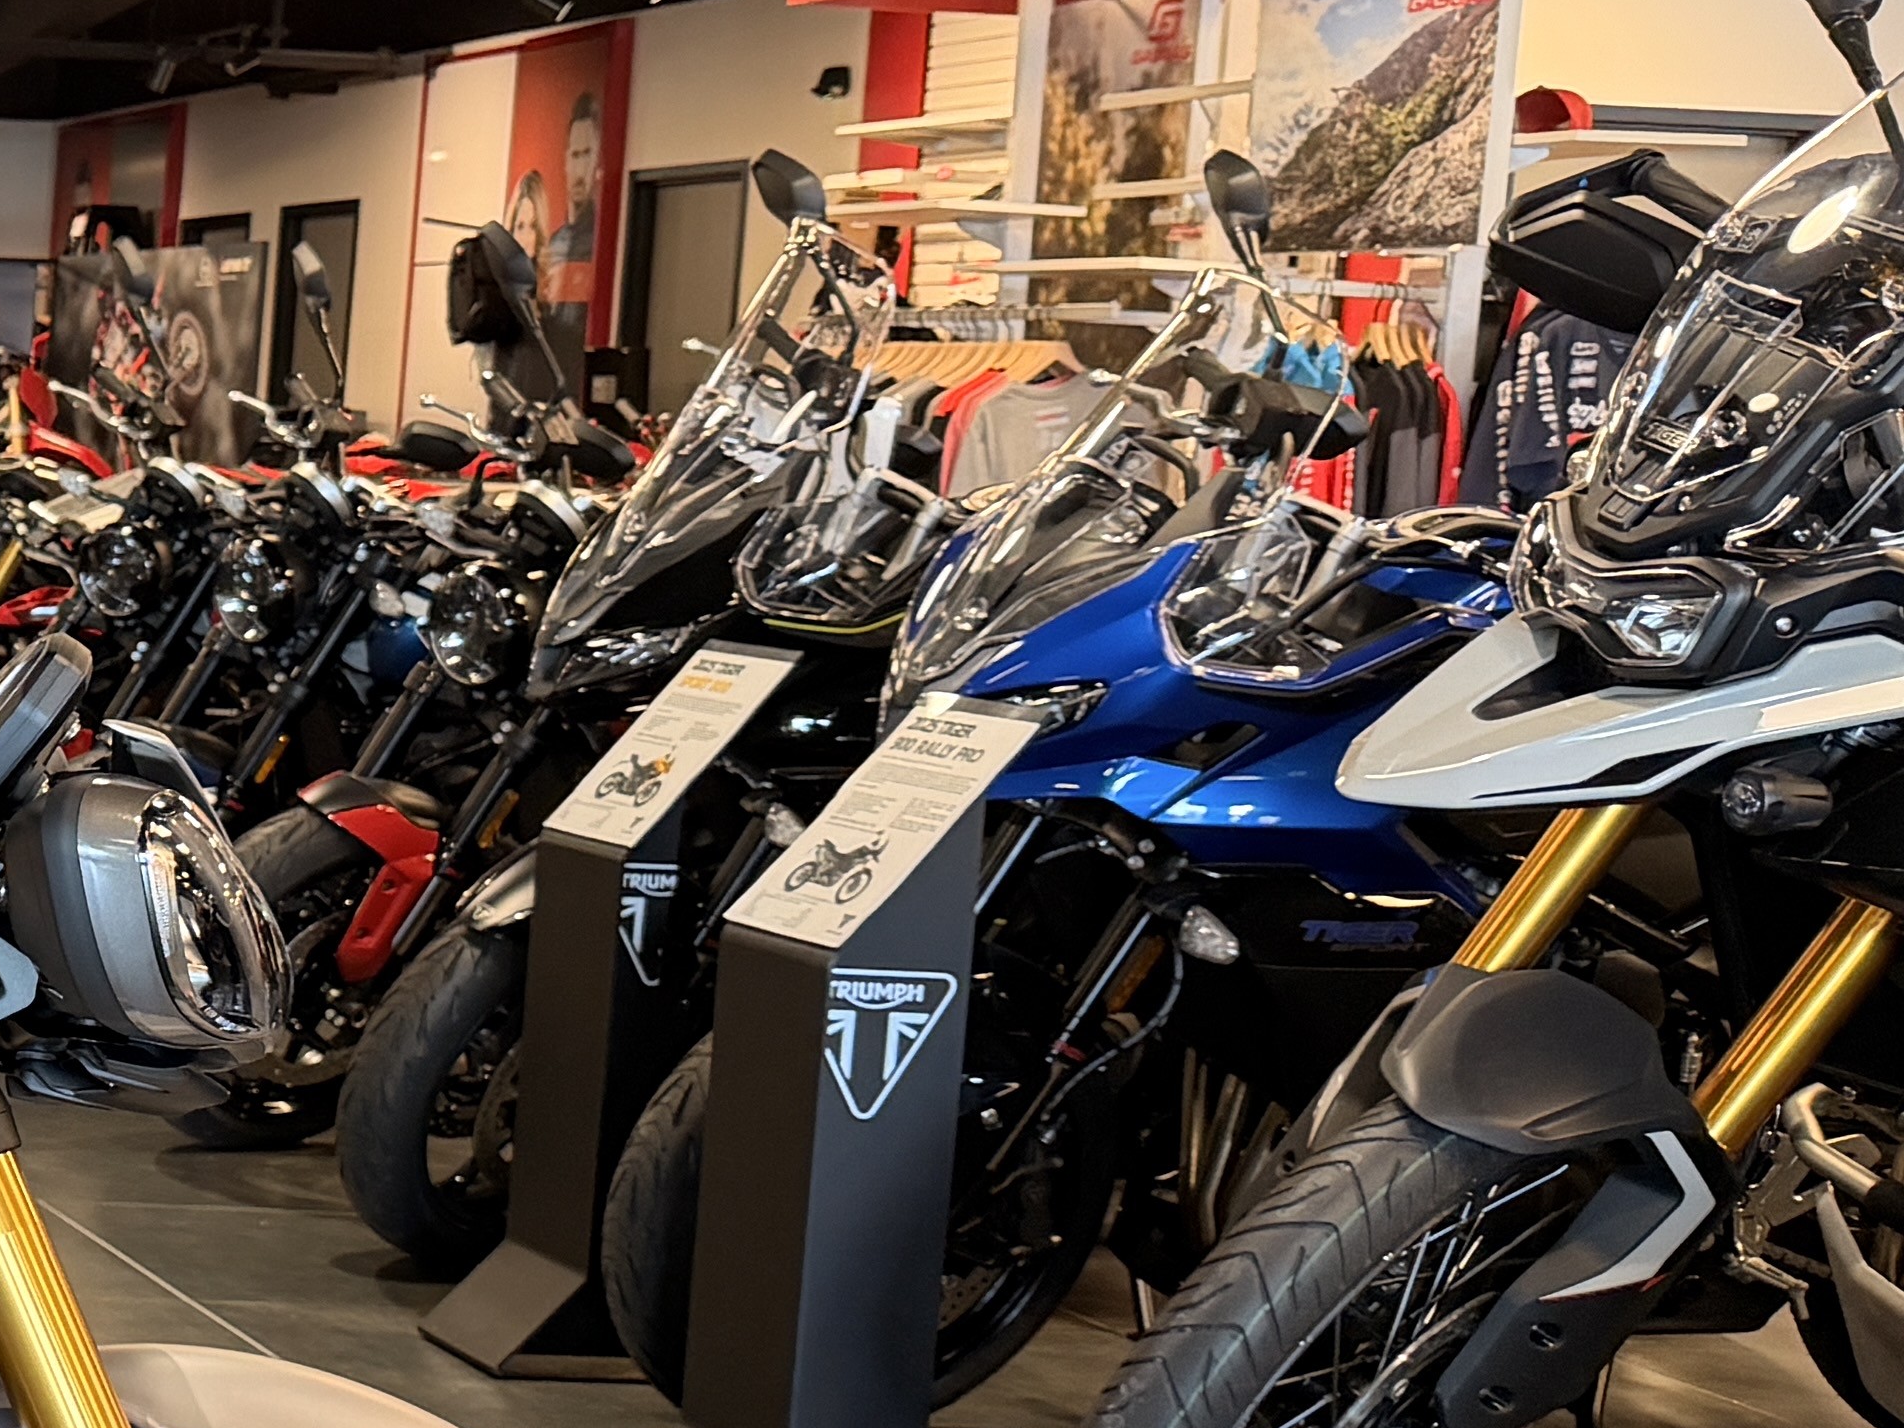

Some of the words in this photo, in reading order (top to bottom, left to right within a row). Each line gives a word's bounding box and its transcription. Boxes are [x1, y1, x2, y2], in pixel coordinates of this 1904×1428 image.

[954, 746, 985, 763] PRO
[622, 872, 679, 898] TRIUM
[829, 980, 925, 1010] TRIUMPH
